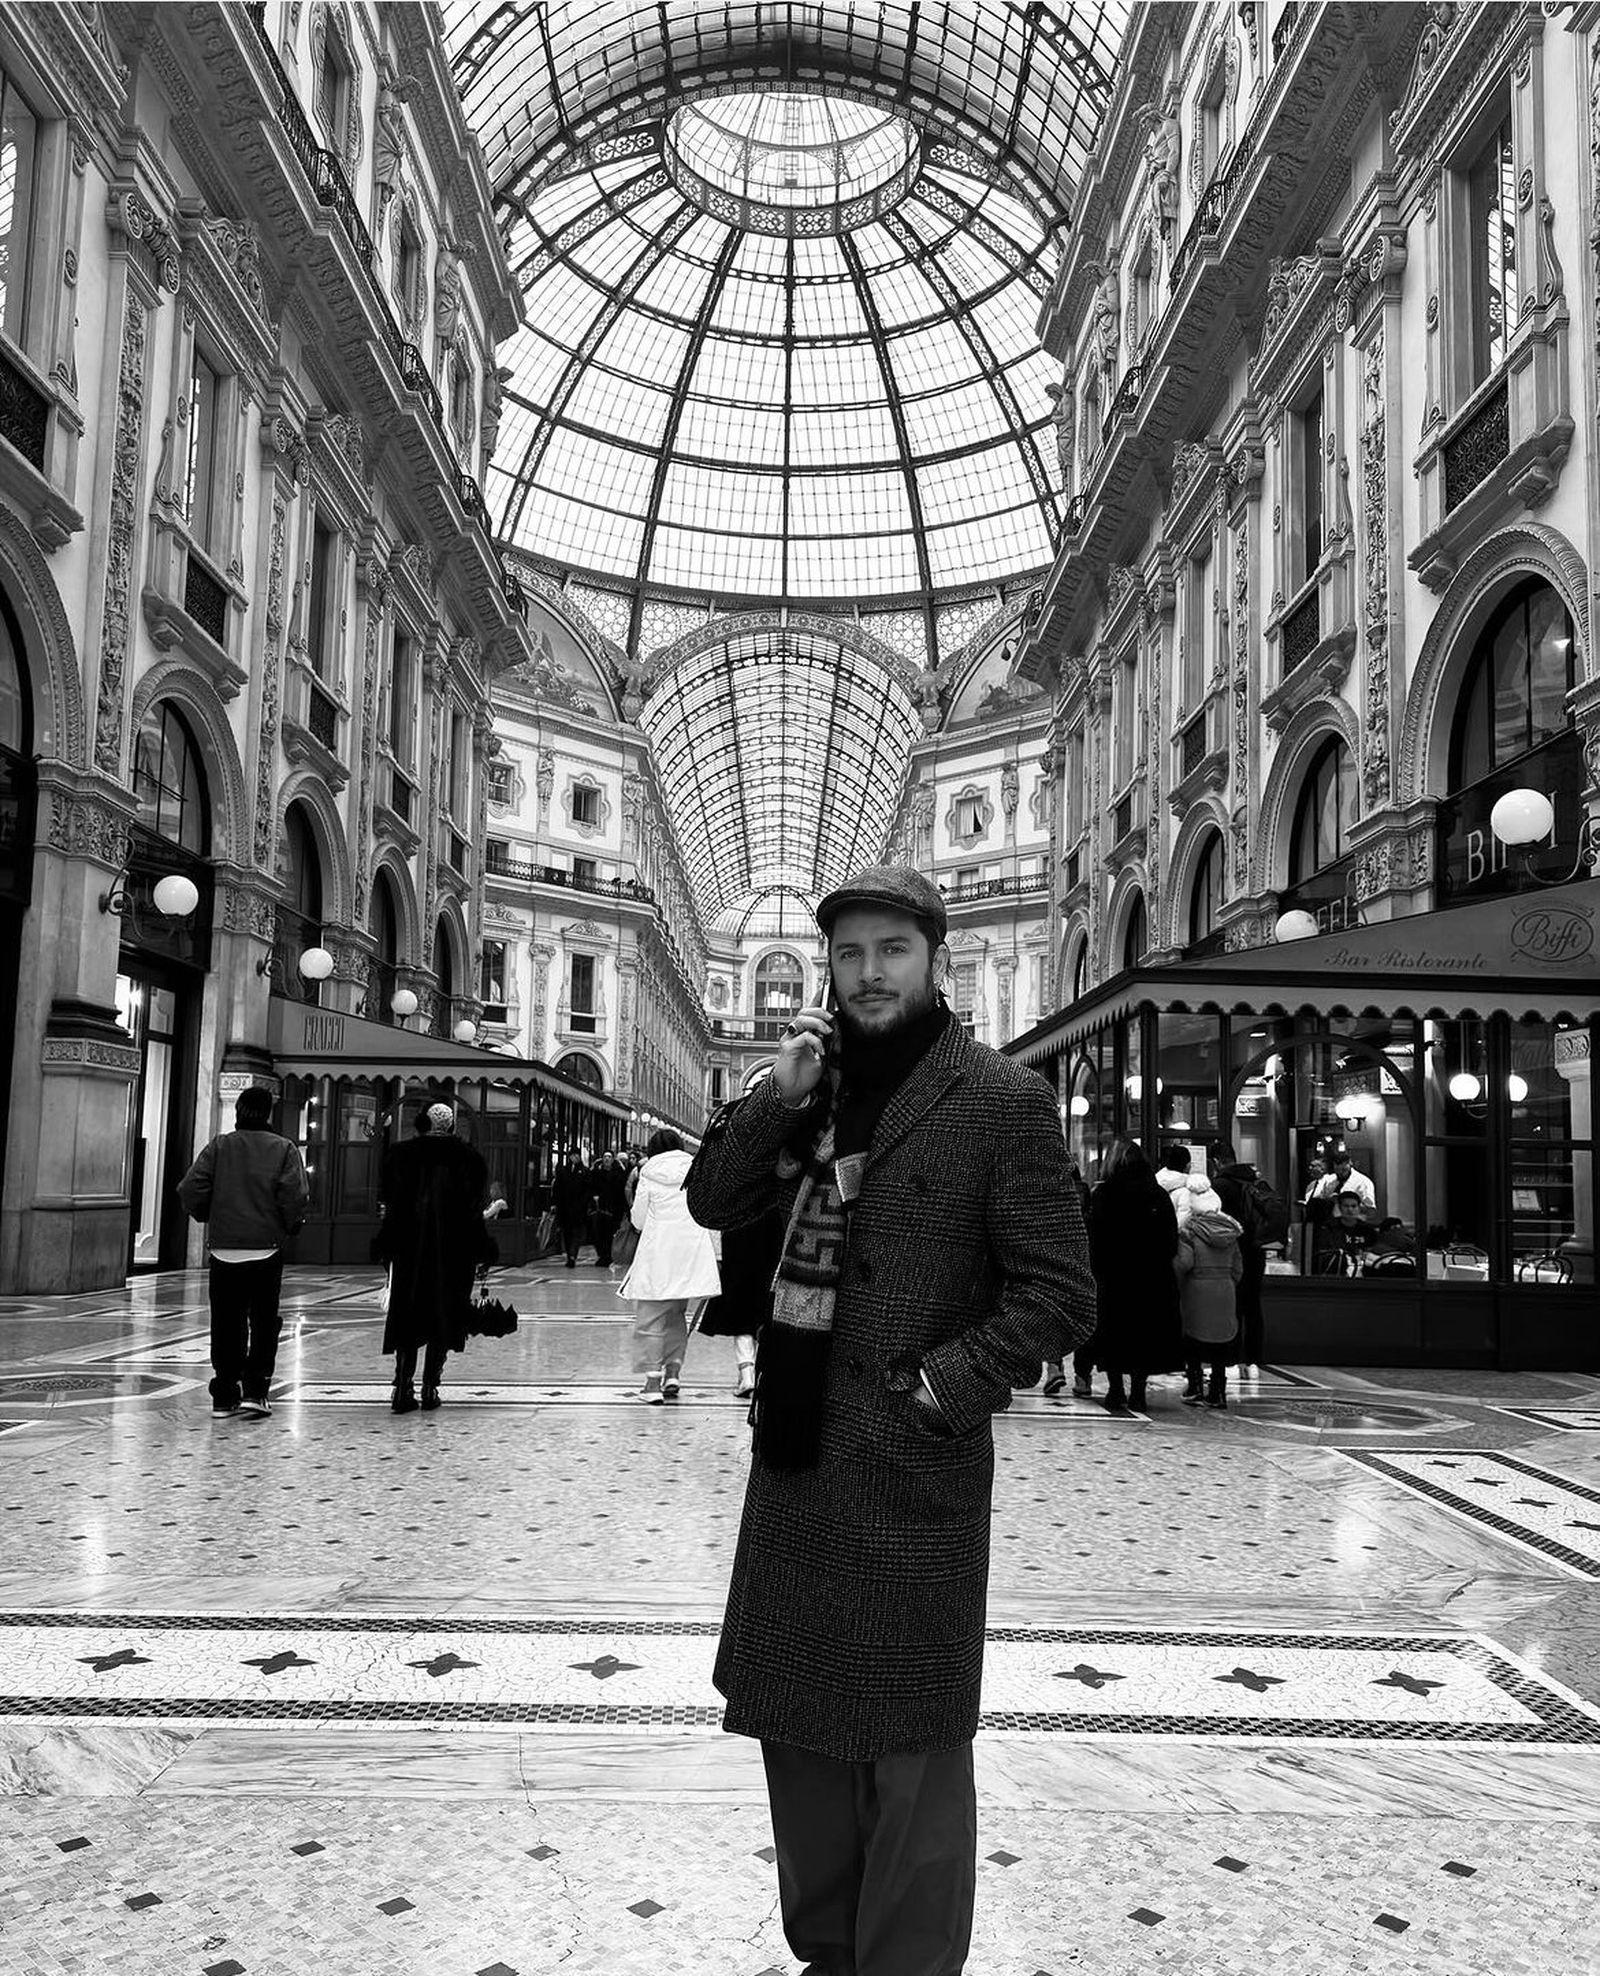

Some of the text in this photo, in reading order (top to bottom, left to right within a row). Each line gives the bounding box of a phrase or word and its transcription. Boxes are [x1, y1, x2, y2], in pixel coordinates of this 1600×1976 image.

[1466, 791, 1558, 884] BII
[1514, 913, 1584, 958] Biffi
[1323, 950, 1488, 969] Bar Ristorante
[303, 1016, 346, 1051] CRACCO
